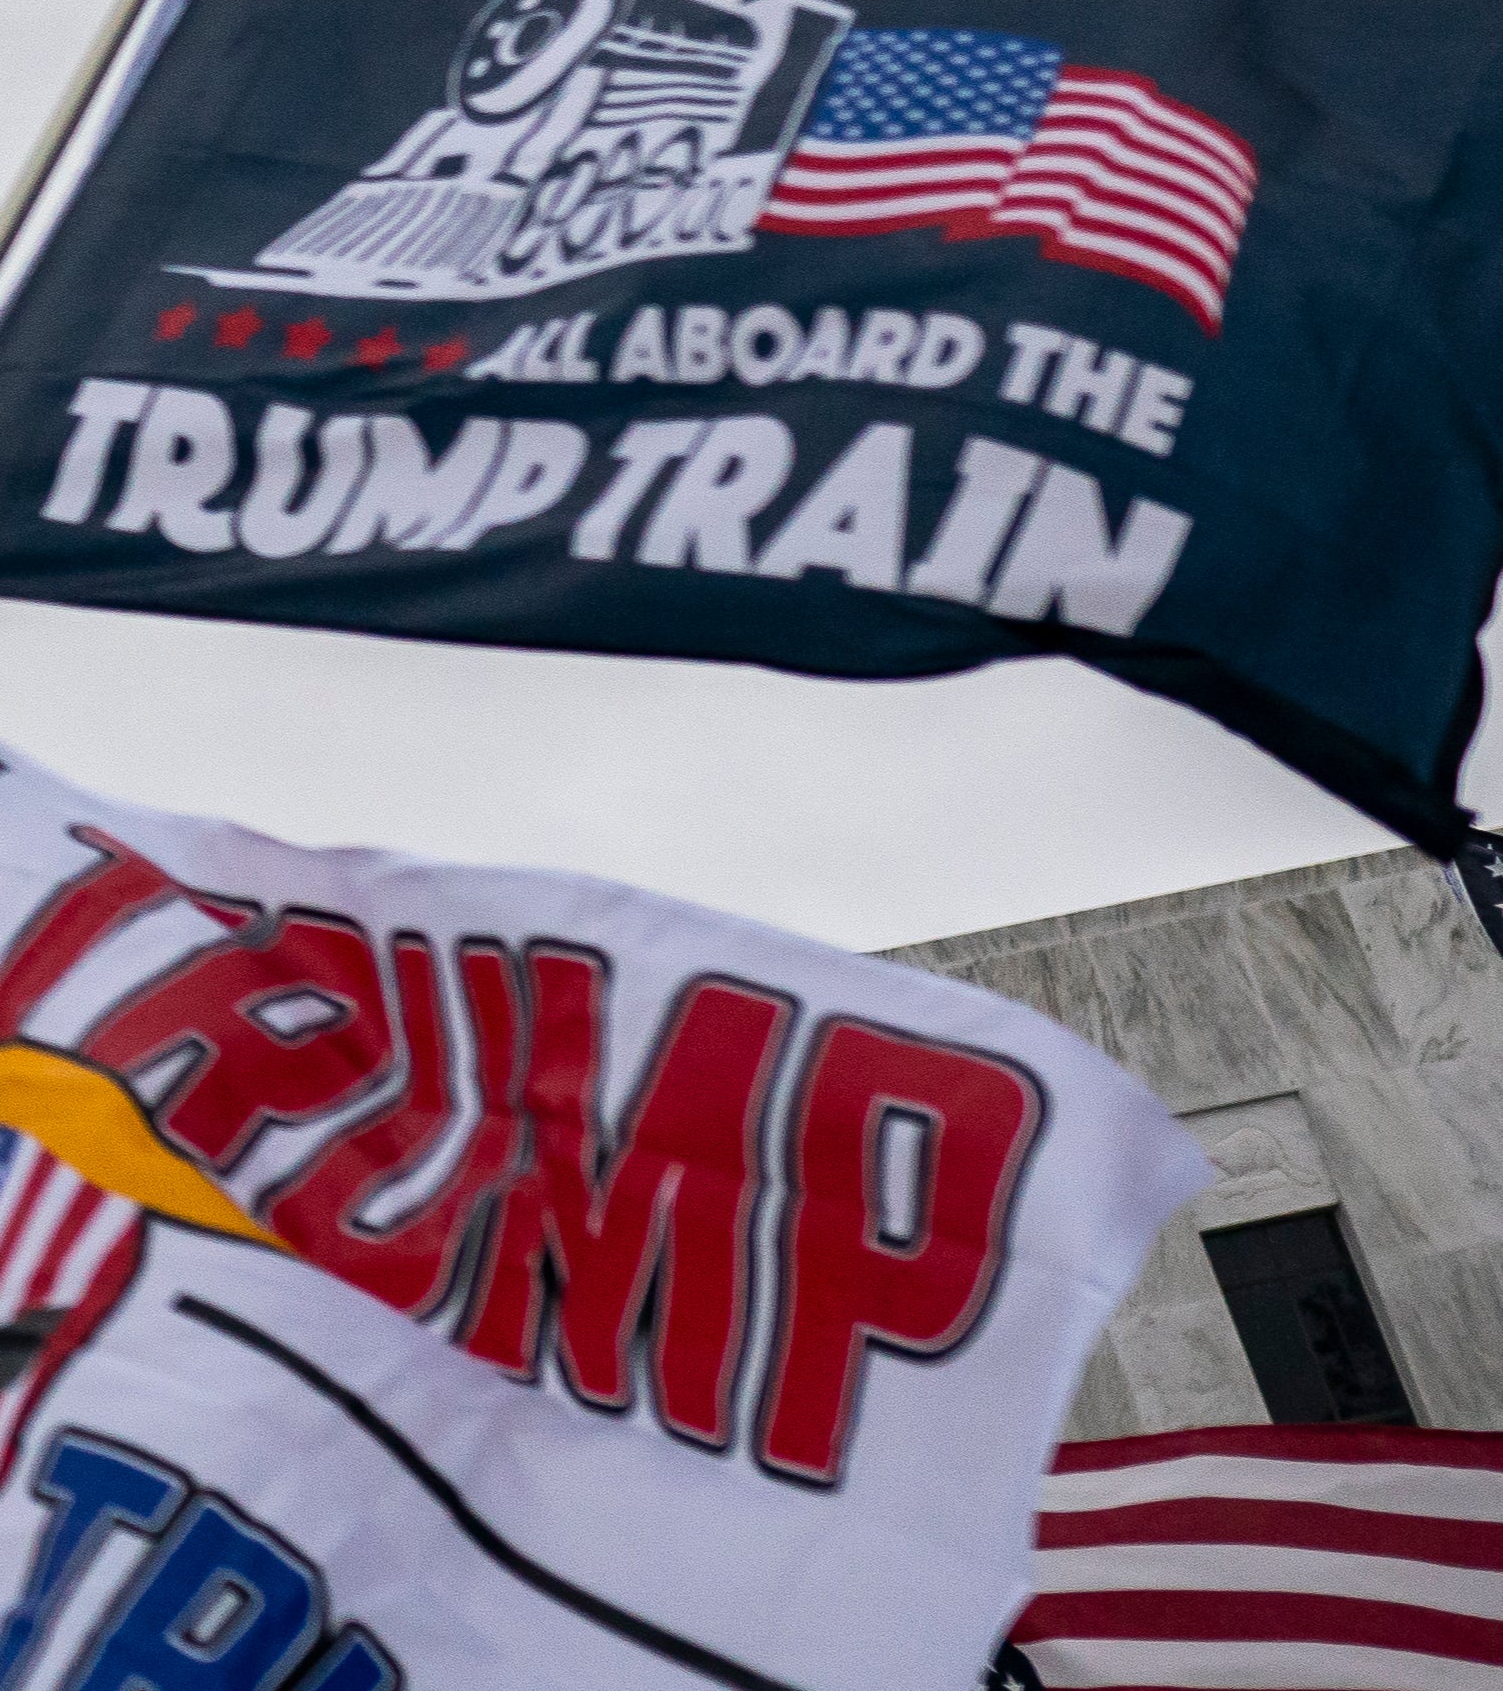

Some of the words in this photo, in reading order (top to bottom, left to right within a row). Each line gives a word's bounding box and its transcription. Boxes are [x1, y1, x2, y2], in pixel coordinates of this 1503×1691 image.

[463, 312, 599, 383] ALL
[609, 303, 986, 390] ABOARD
[999, 321, 1195, 458] THE
[39, 377, 590, 559] TRUMP
[570, 414, 1195, 639] TRAIN
